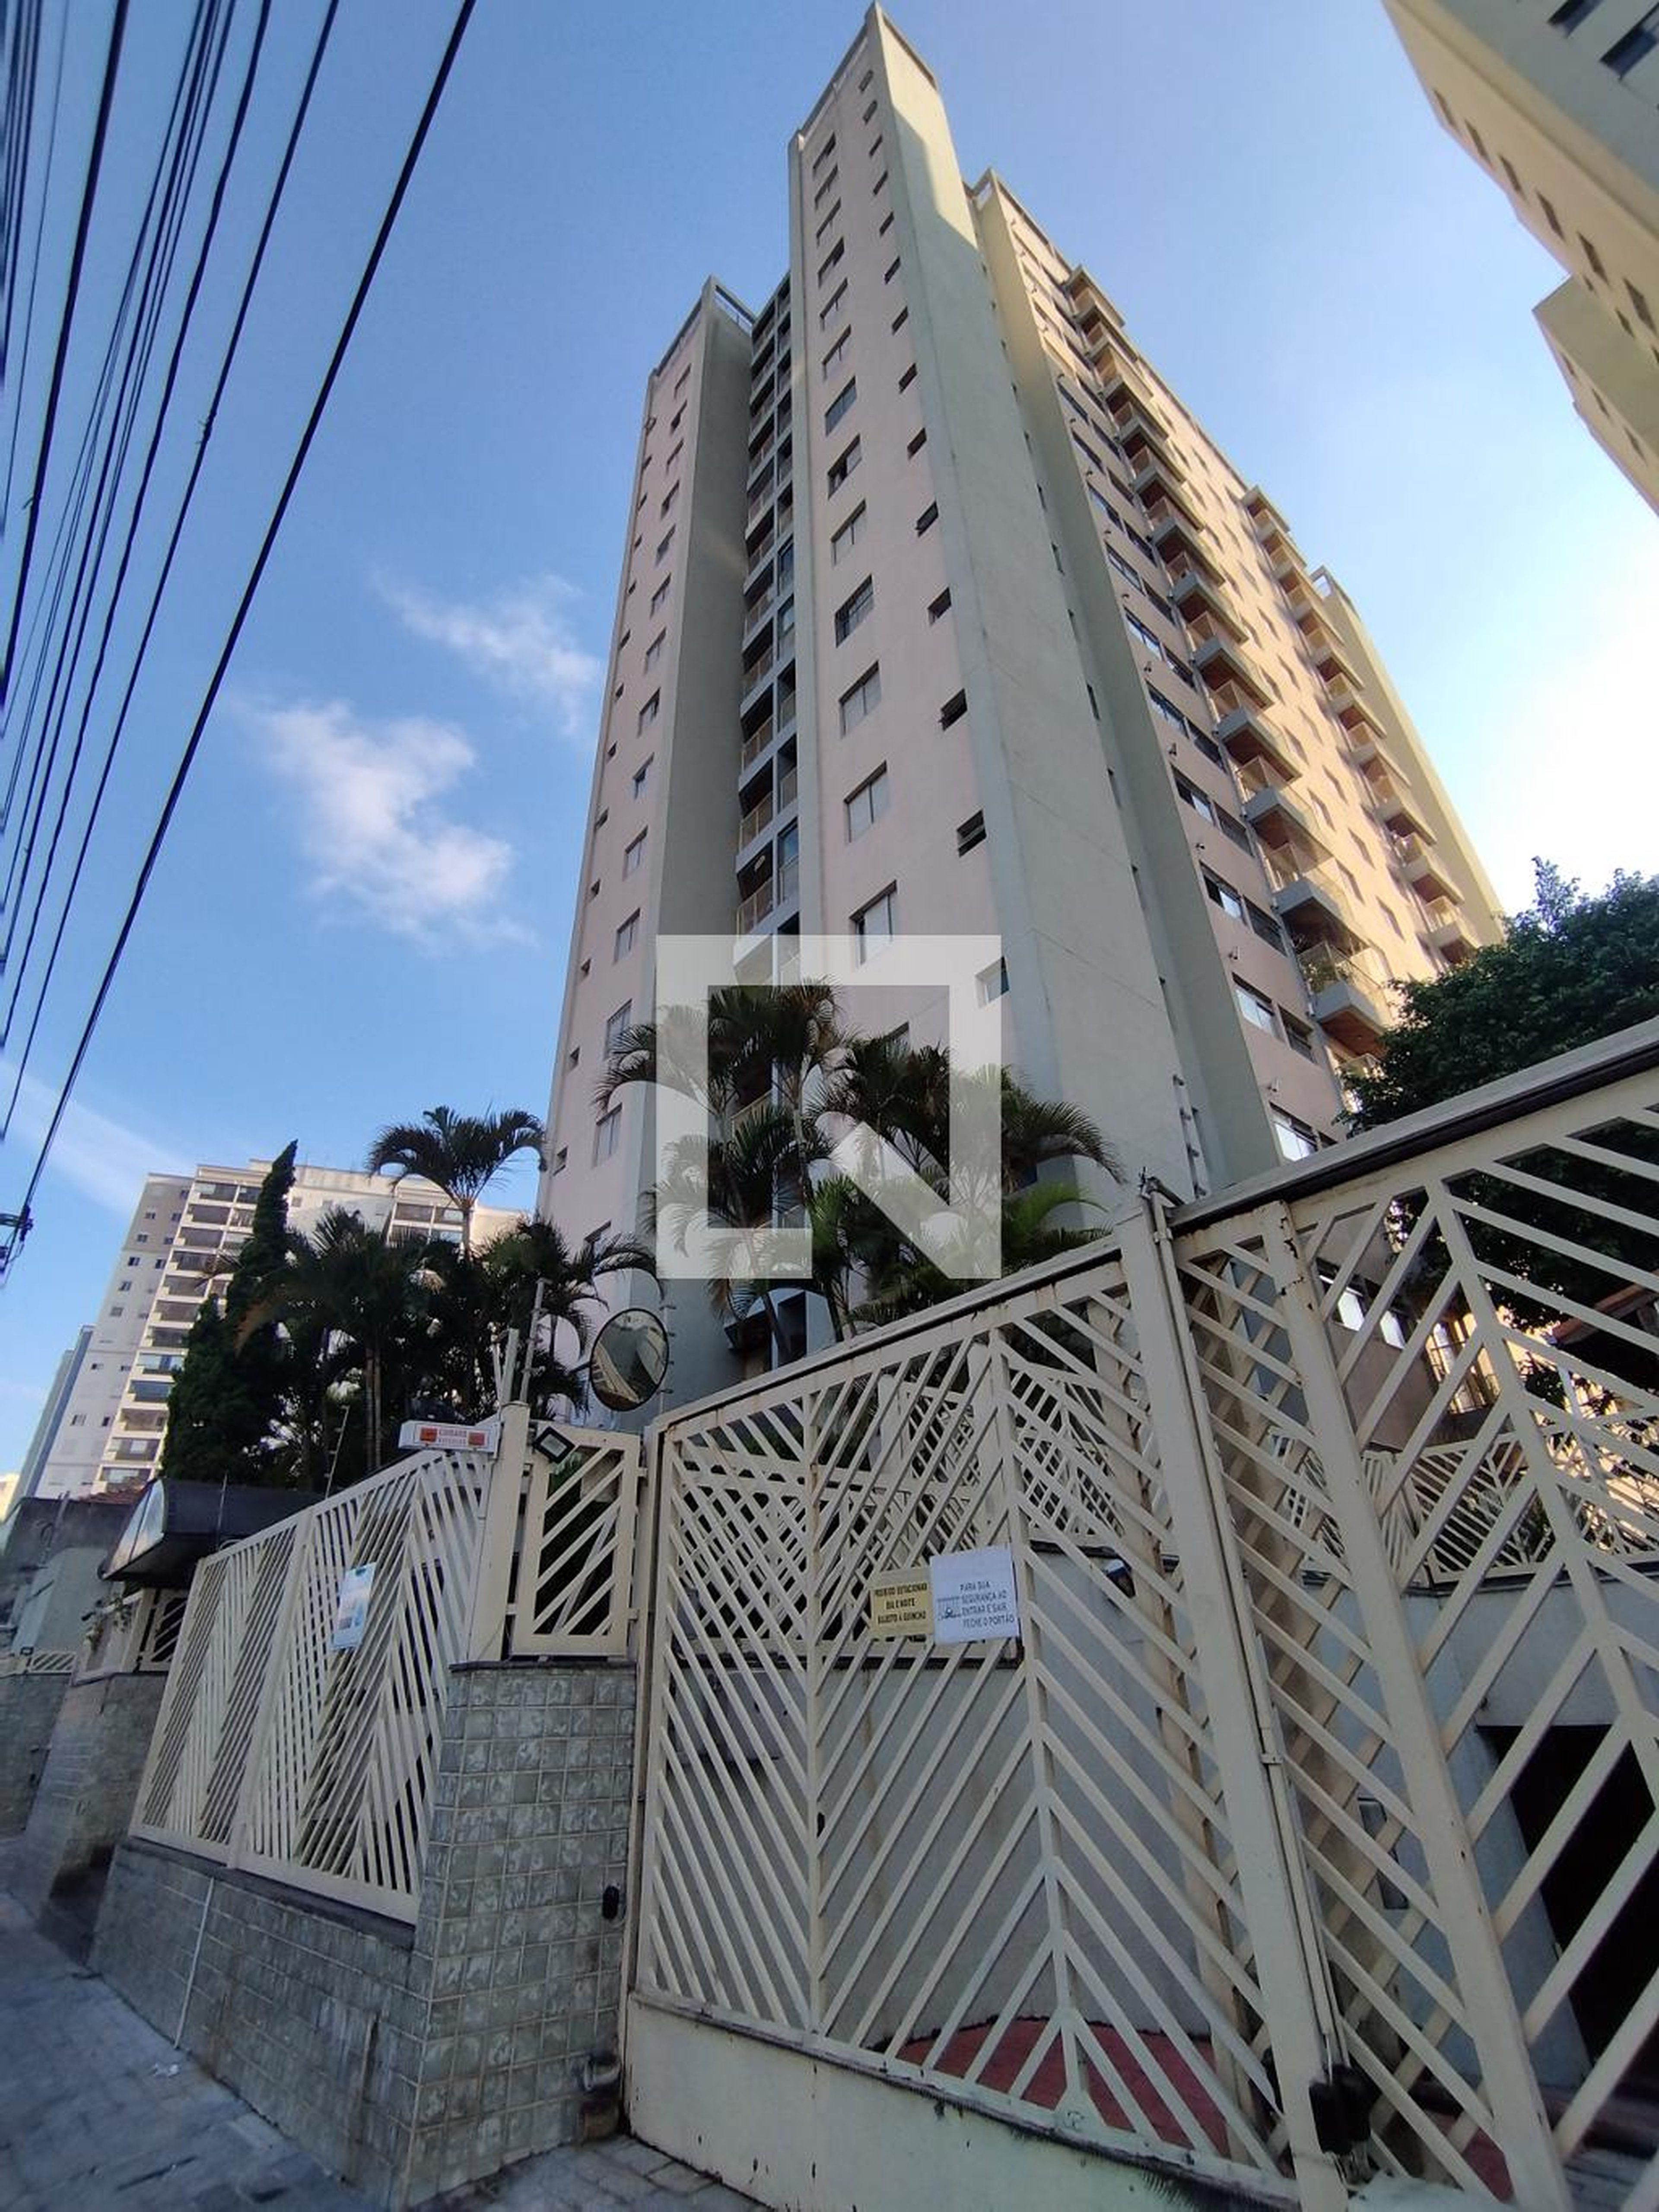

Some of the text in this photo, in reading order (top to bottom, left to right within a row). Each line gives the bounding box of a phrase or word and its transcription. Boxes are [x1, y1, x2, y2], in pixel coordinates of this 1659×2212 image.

[960, 1582, 976, 1591] PARA
[962, 1605, 985, 1616] ENTRAR
[987, 1604, 991, 1613] E
[983, 1617, 988, 1626] O
